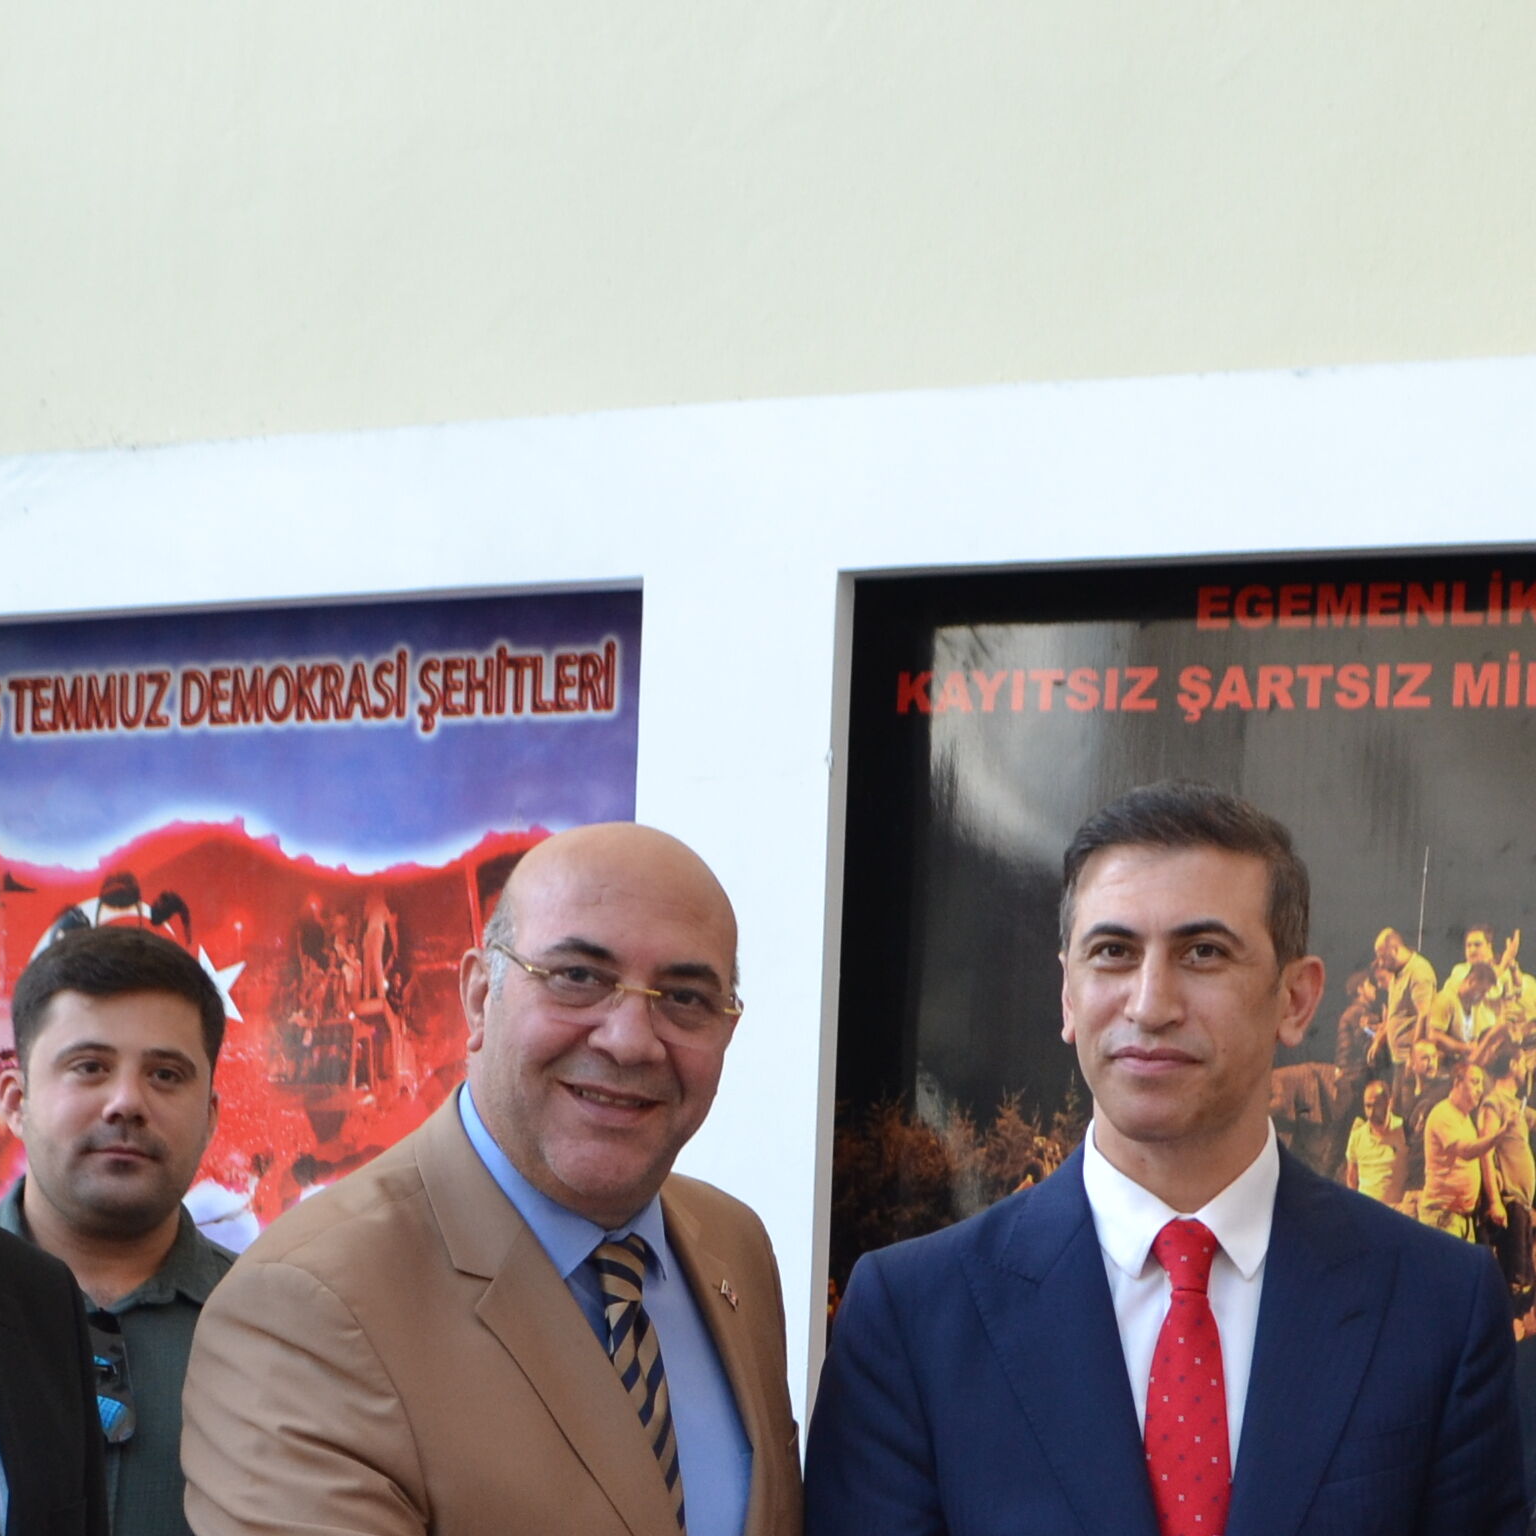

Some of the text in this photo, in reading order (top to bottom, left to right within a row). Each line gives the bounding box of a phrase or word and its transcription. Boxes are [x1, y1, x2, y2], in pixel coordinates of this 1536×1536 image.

[9, 671, 171, 734] TEMMUZ
[180, 648, 408, 727] DEMOKRASİ
[418, 640, 617, 734] ŞEHİTLERİ
[896, 666, 1159, 714] KAYITSIZ
[1177, 661, 1432, 722] ŞARTSIZ
